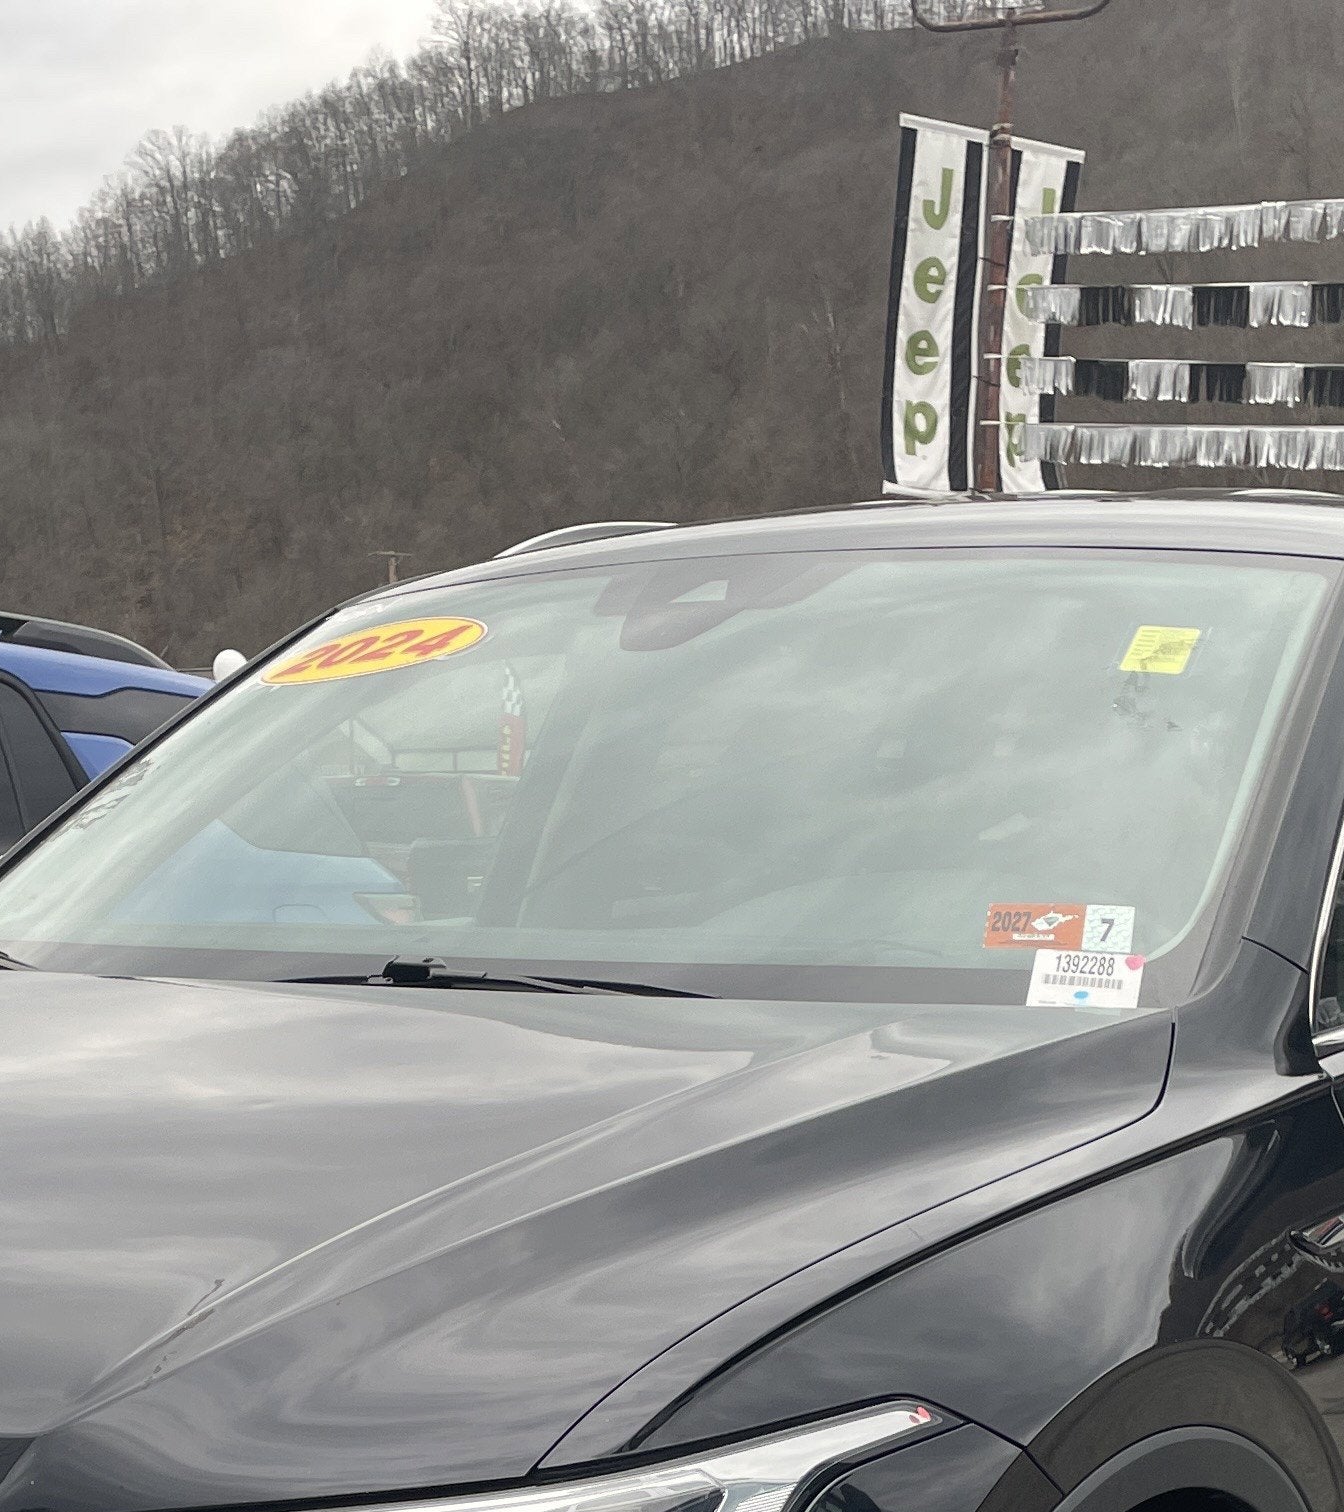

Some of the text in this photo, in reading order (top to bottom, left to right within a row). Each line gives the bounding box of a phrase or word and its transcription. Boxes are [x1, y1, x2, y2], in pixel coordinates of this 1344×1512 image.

[904, 167, 955, 457] Jeep
[269, 624, 474, 680] 2024
[991, 911, 1032, 933] 2027
[1100, 918, 1115, 942] 7
[1056, 954, 1115, 977] 1392288
